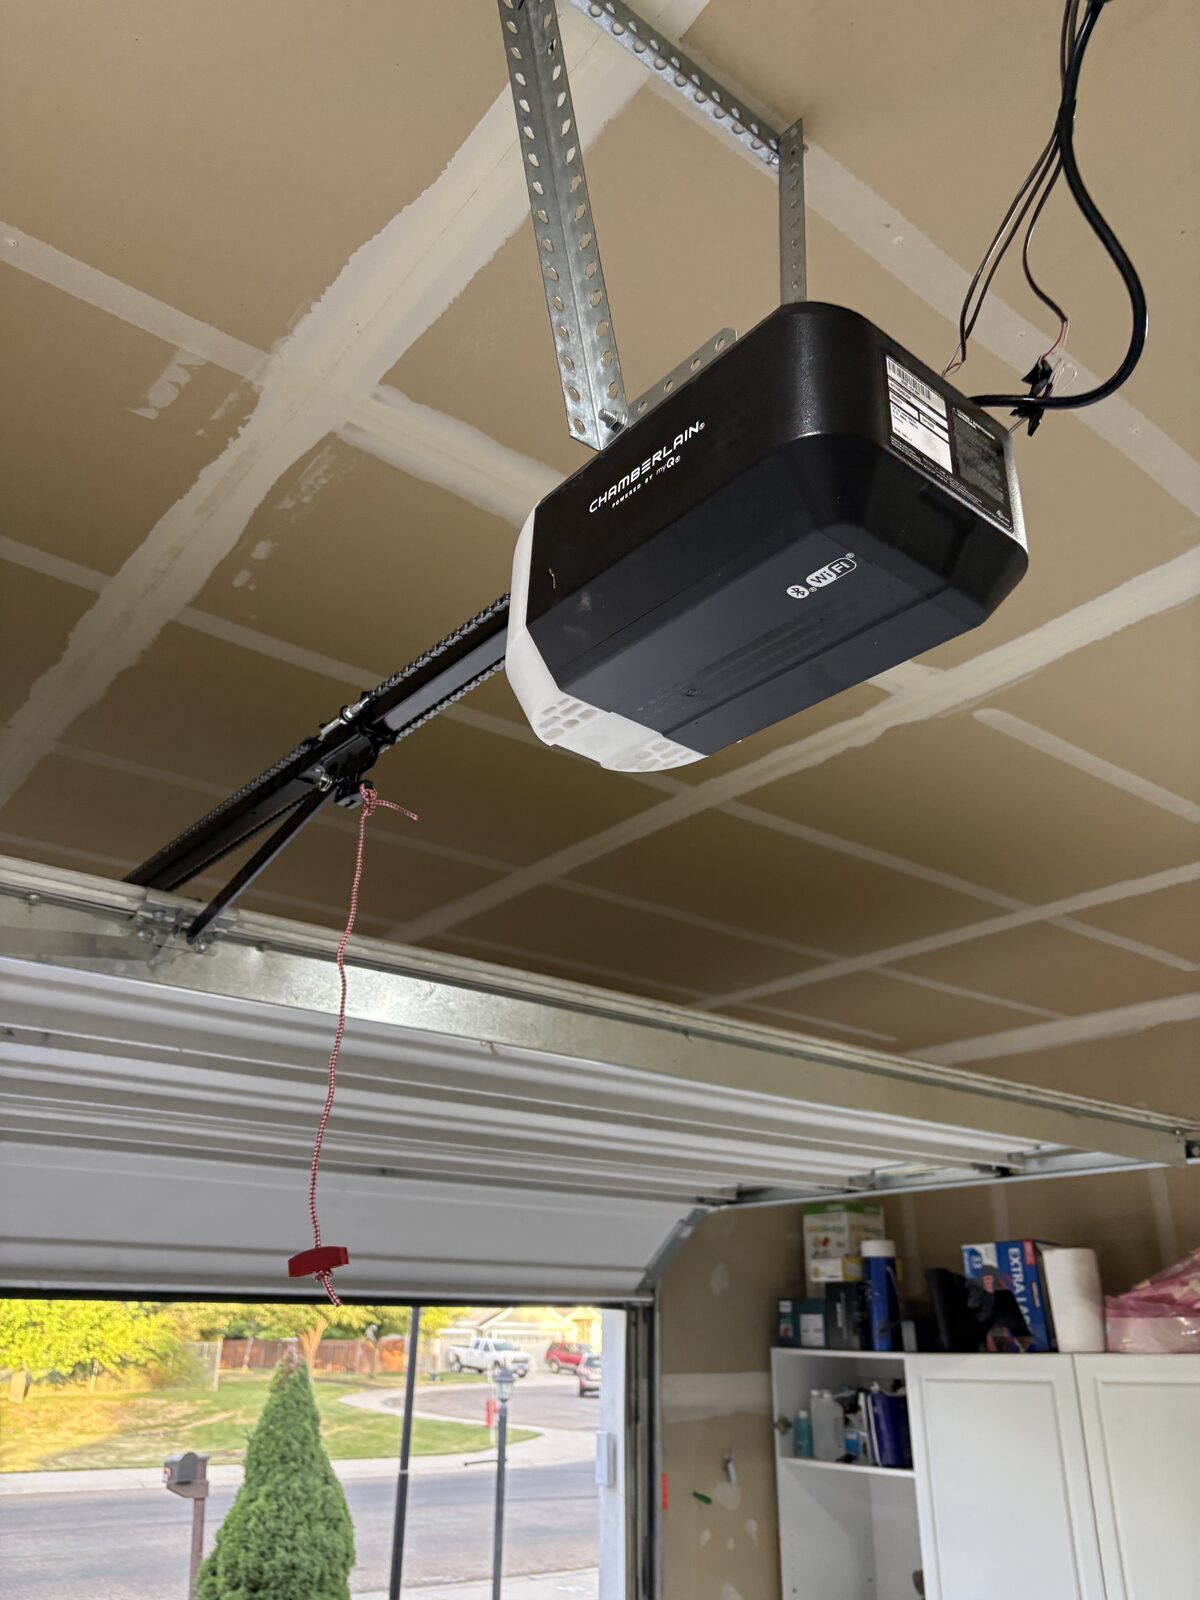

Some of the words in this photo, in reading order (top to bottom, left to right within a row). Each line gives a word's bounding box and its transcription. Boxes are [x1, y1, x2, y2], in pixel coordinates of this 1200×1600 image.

[589, 421, 701, 513] CHAMBERLAIN
[611, 483, 642, 509] POWERED
[644, 474, 653, 484] BY
[1008, 1248, 1026, 1295] EXTRA
